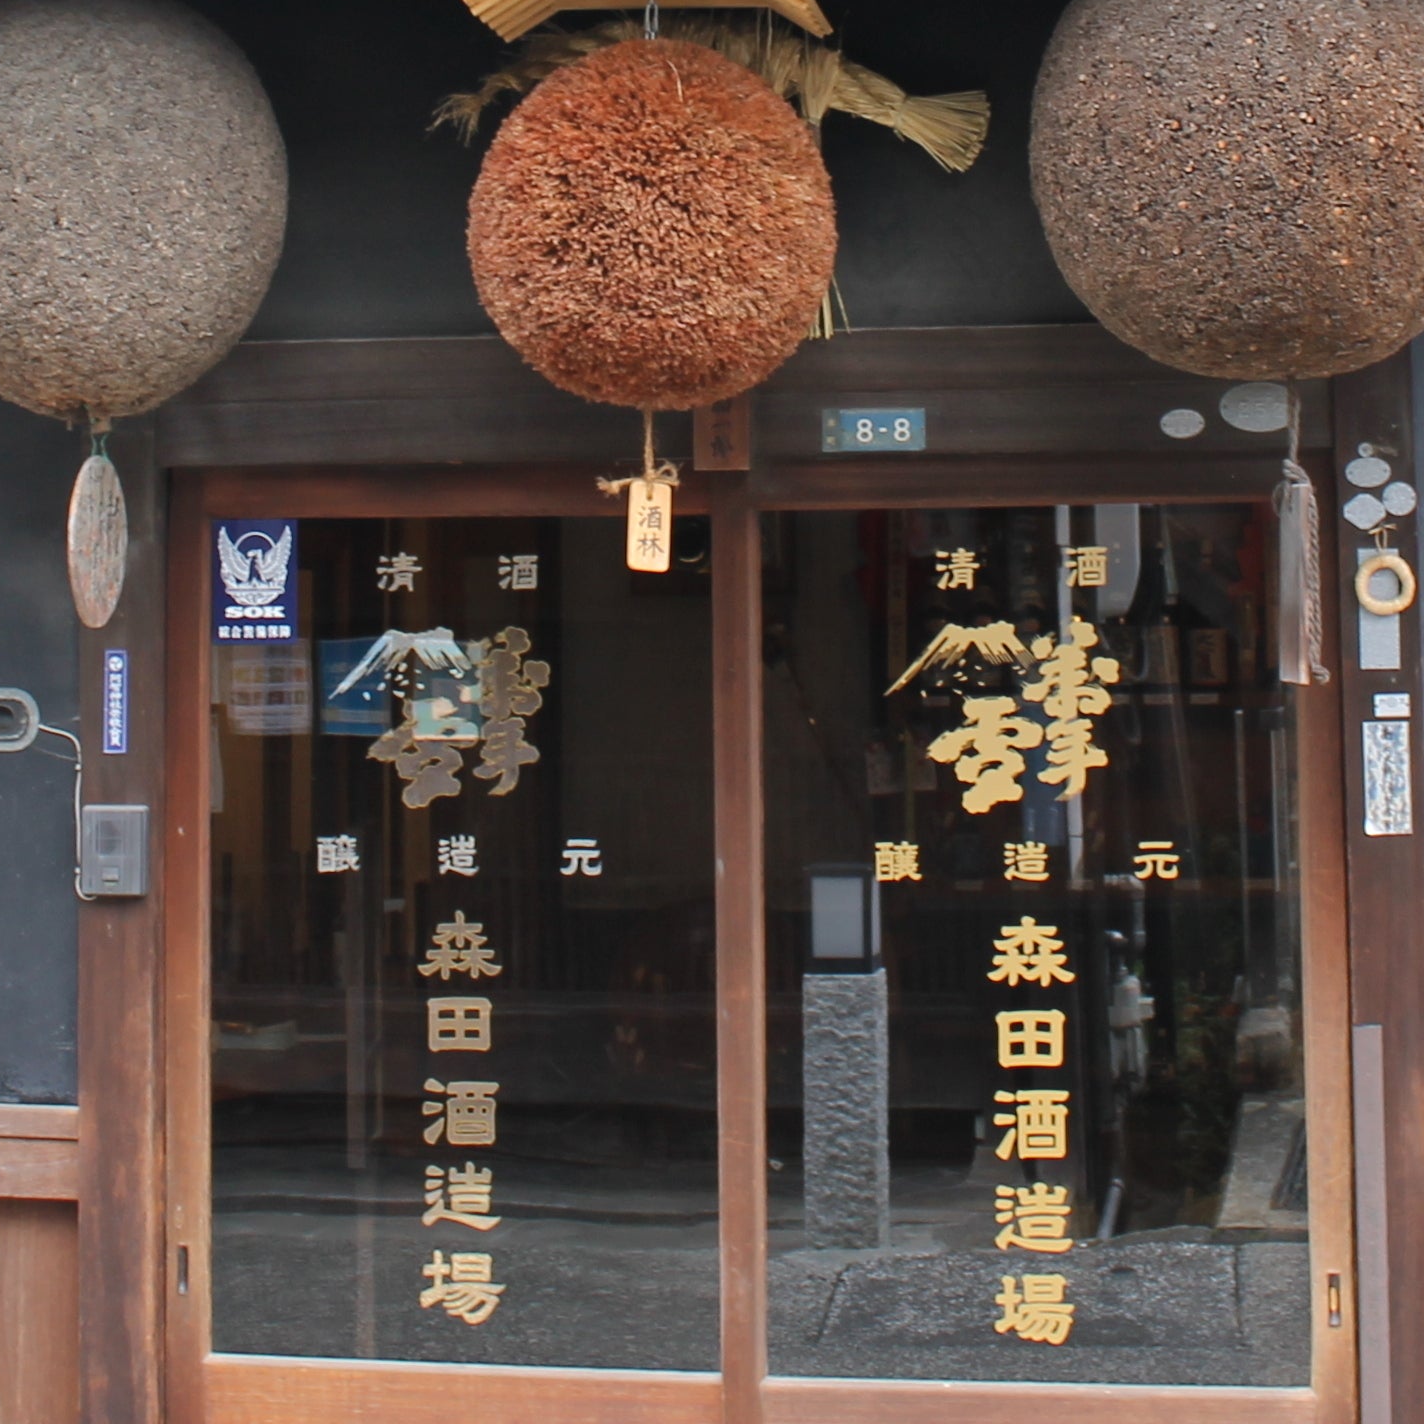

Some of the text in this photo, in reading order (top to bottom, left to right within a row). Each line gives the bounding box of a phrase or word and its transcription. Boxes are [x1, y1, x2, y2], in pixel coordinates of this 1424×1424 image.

[856, 418, 911, 443] 8-8
[636, 505, 665, 558] 酒林
[224, 605, 286, 619] SOK
[417, 909, 507, 1325] 森田酒造場
[986, 915, 1076, 1346] 森田酒造場
